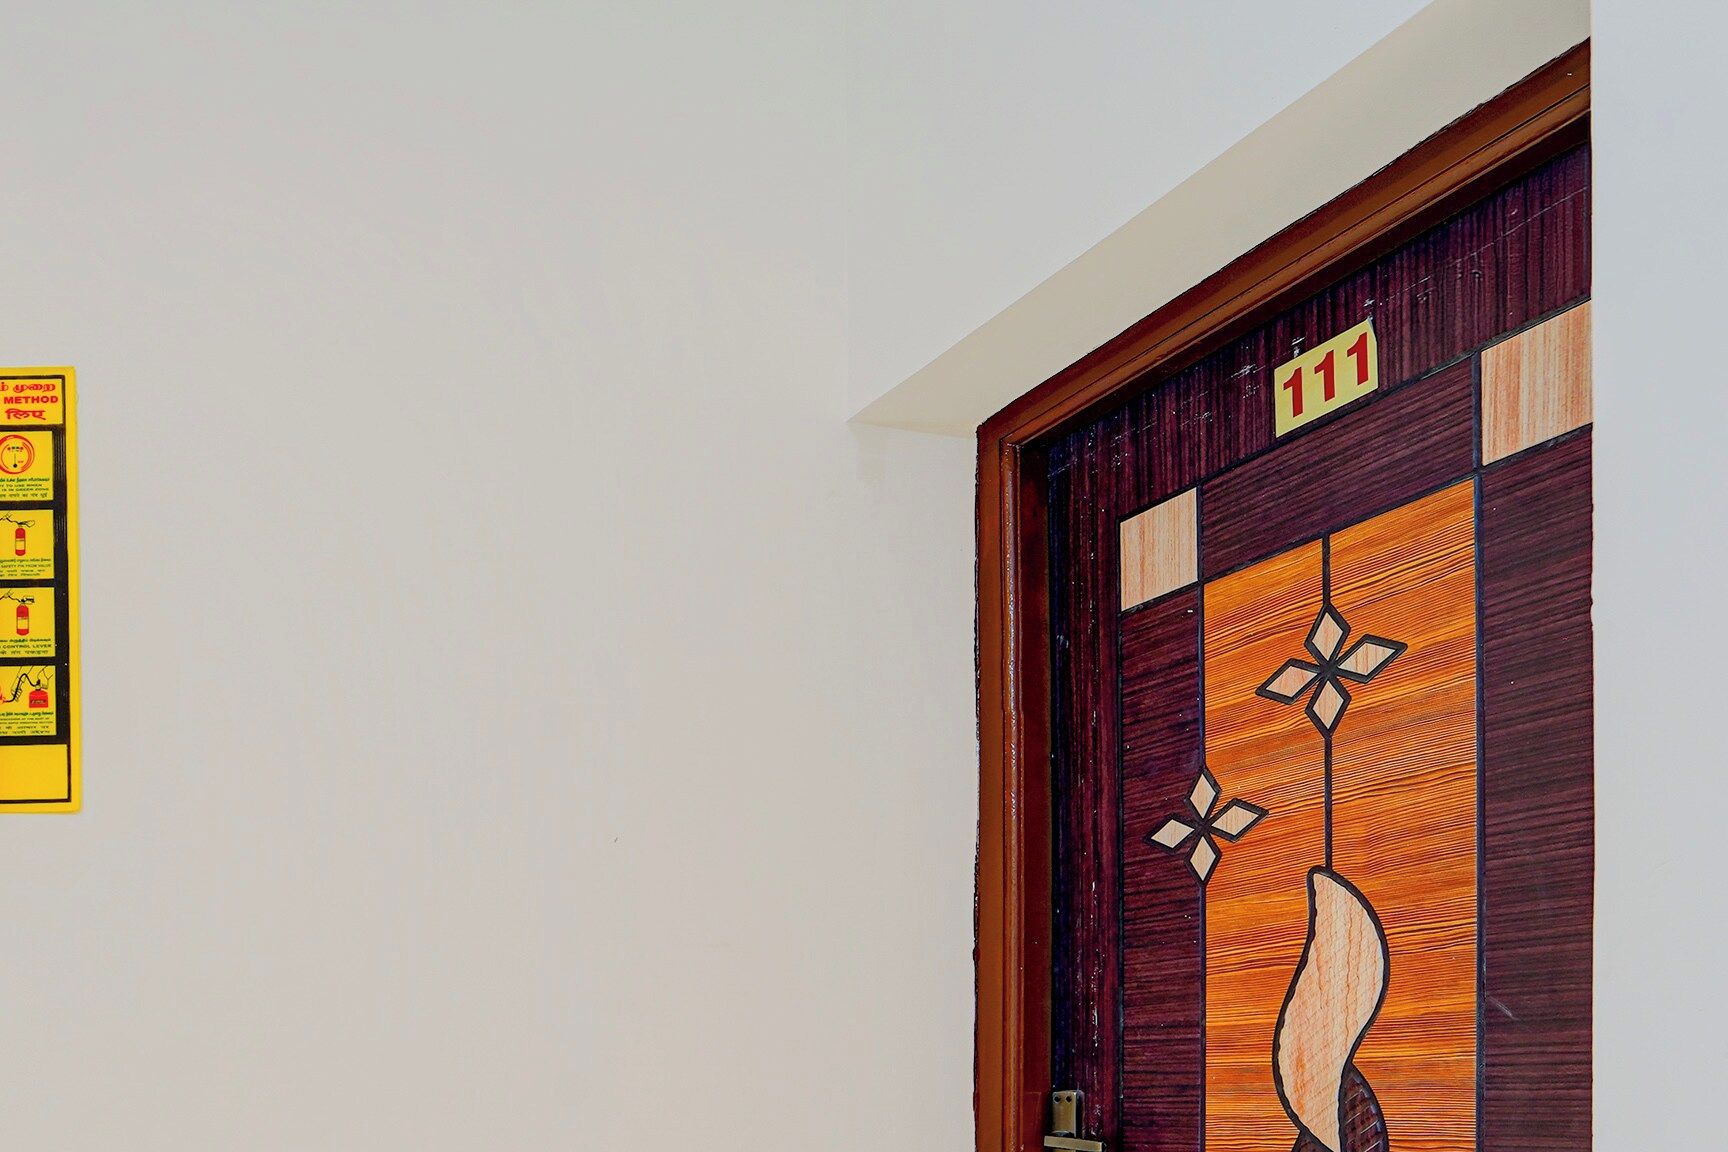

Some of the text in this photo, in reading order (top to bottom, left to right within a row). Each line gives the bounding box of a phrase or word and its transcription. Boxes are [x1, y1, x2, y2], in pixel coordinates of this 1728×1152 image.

[1283, 332, 1369, 417] 111
[3, 396, 59, 405] METHOD
[5, 408, 47, 421] लिए
